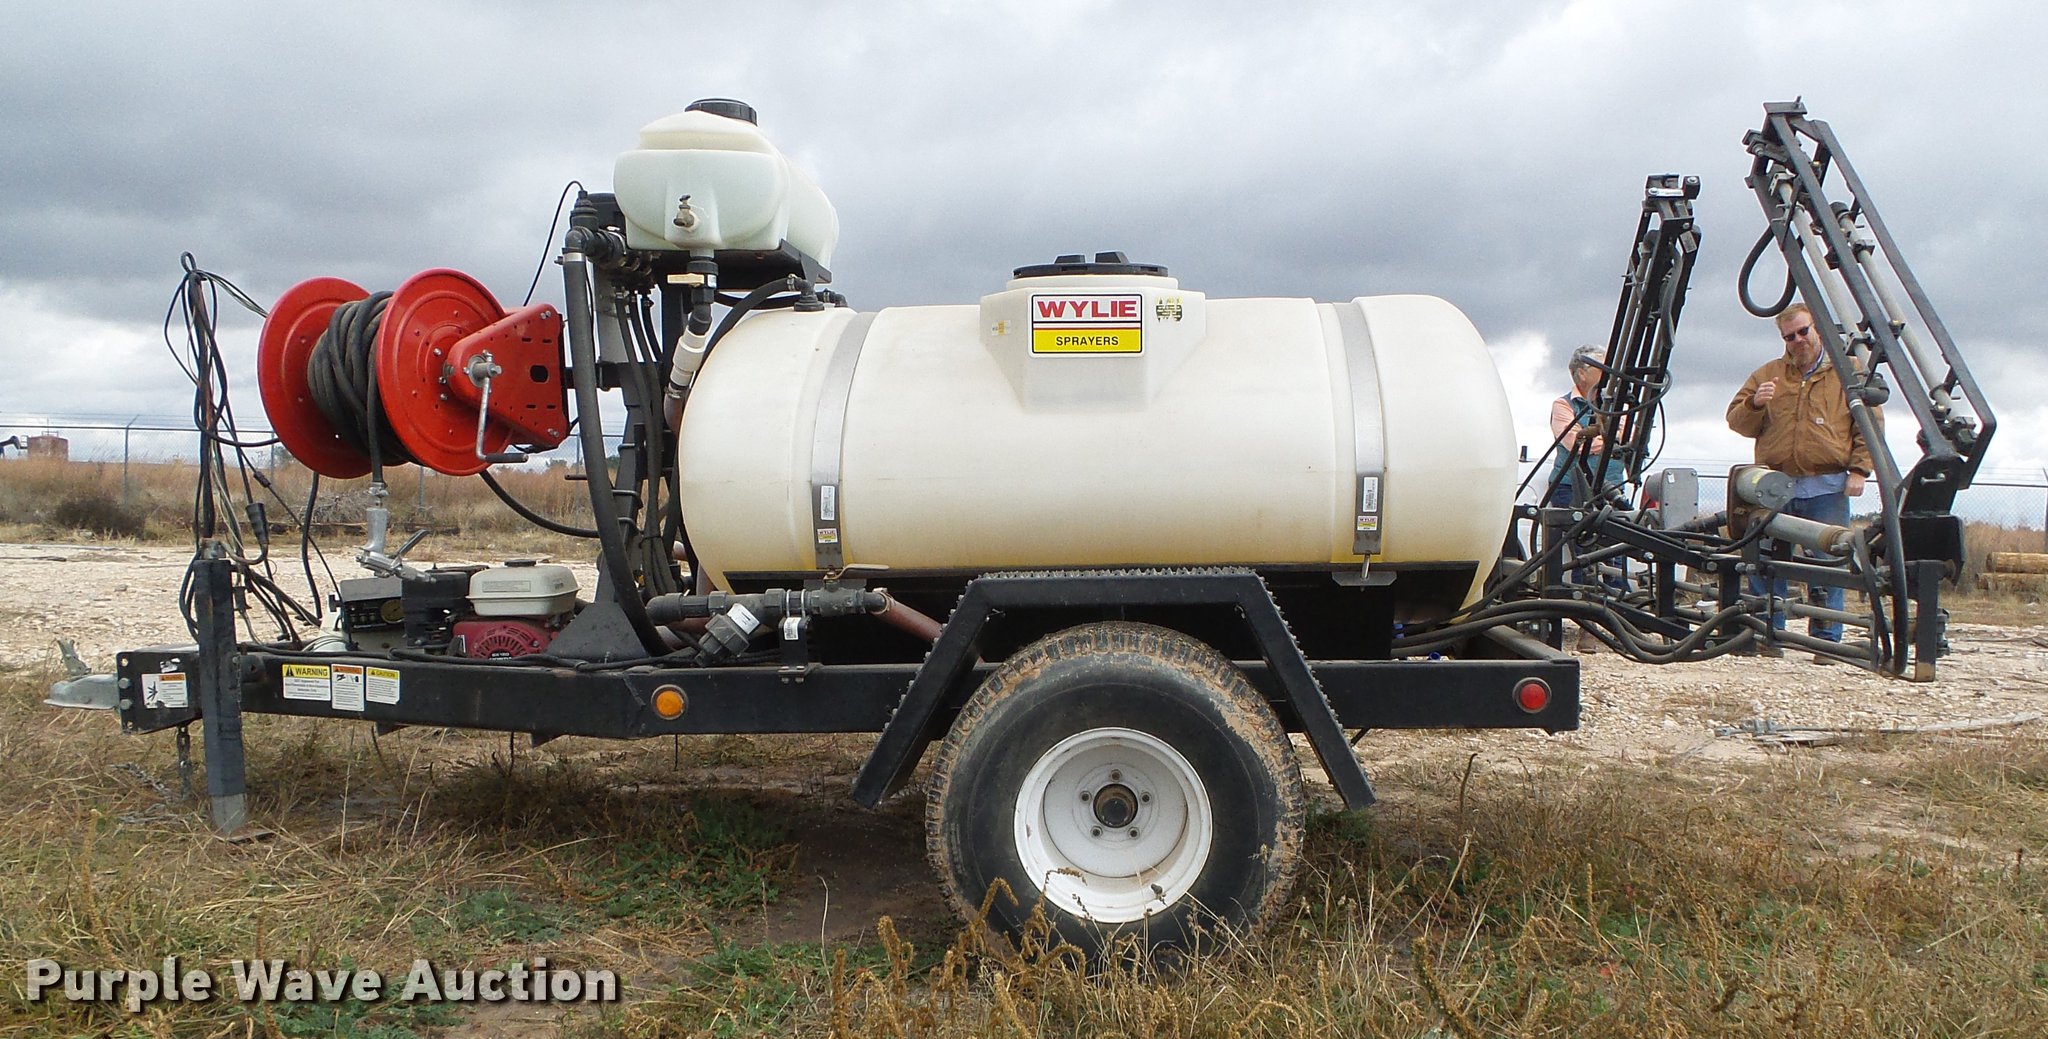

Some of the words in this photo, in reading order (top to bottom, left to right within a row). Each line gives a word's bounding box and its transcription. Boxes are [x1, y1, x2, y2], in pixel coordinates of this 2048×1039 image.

[1037, 300, 1138, 318] WYLIE
[1055, 336, 1120, 346] SPRAYERS
[295, 668, 328, 677] WARNING
